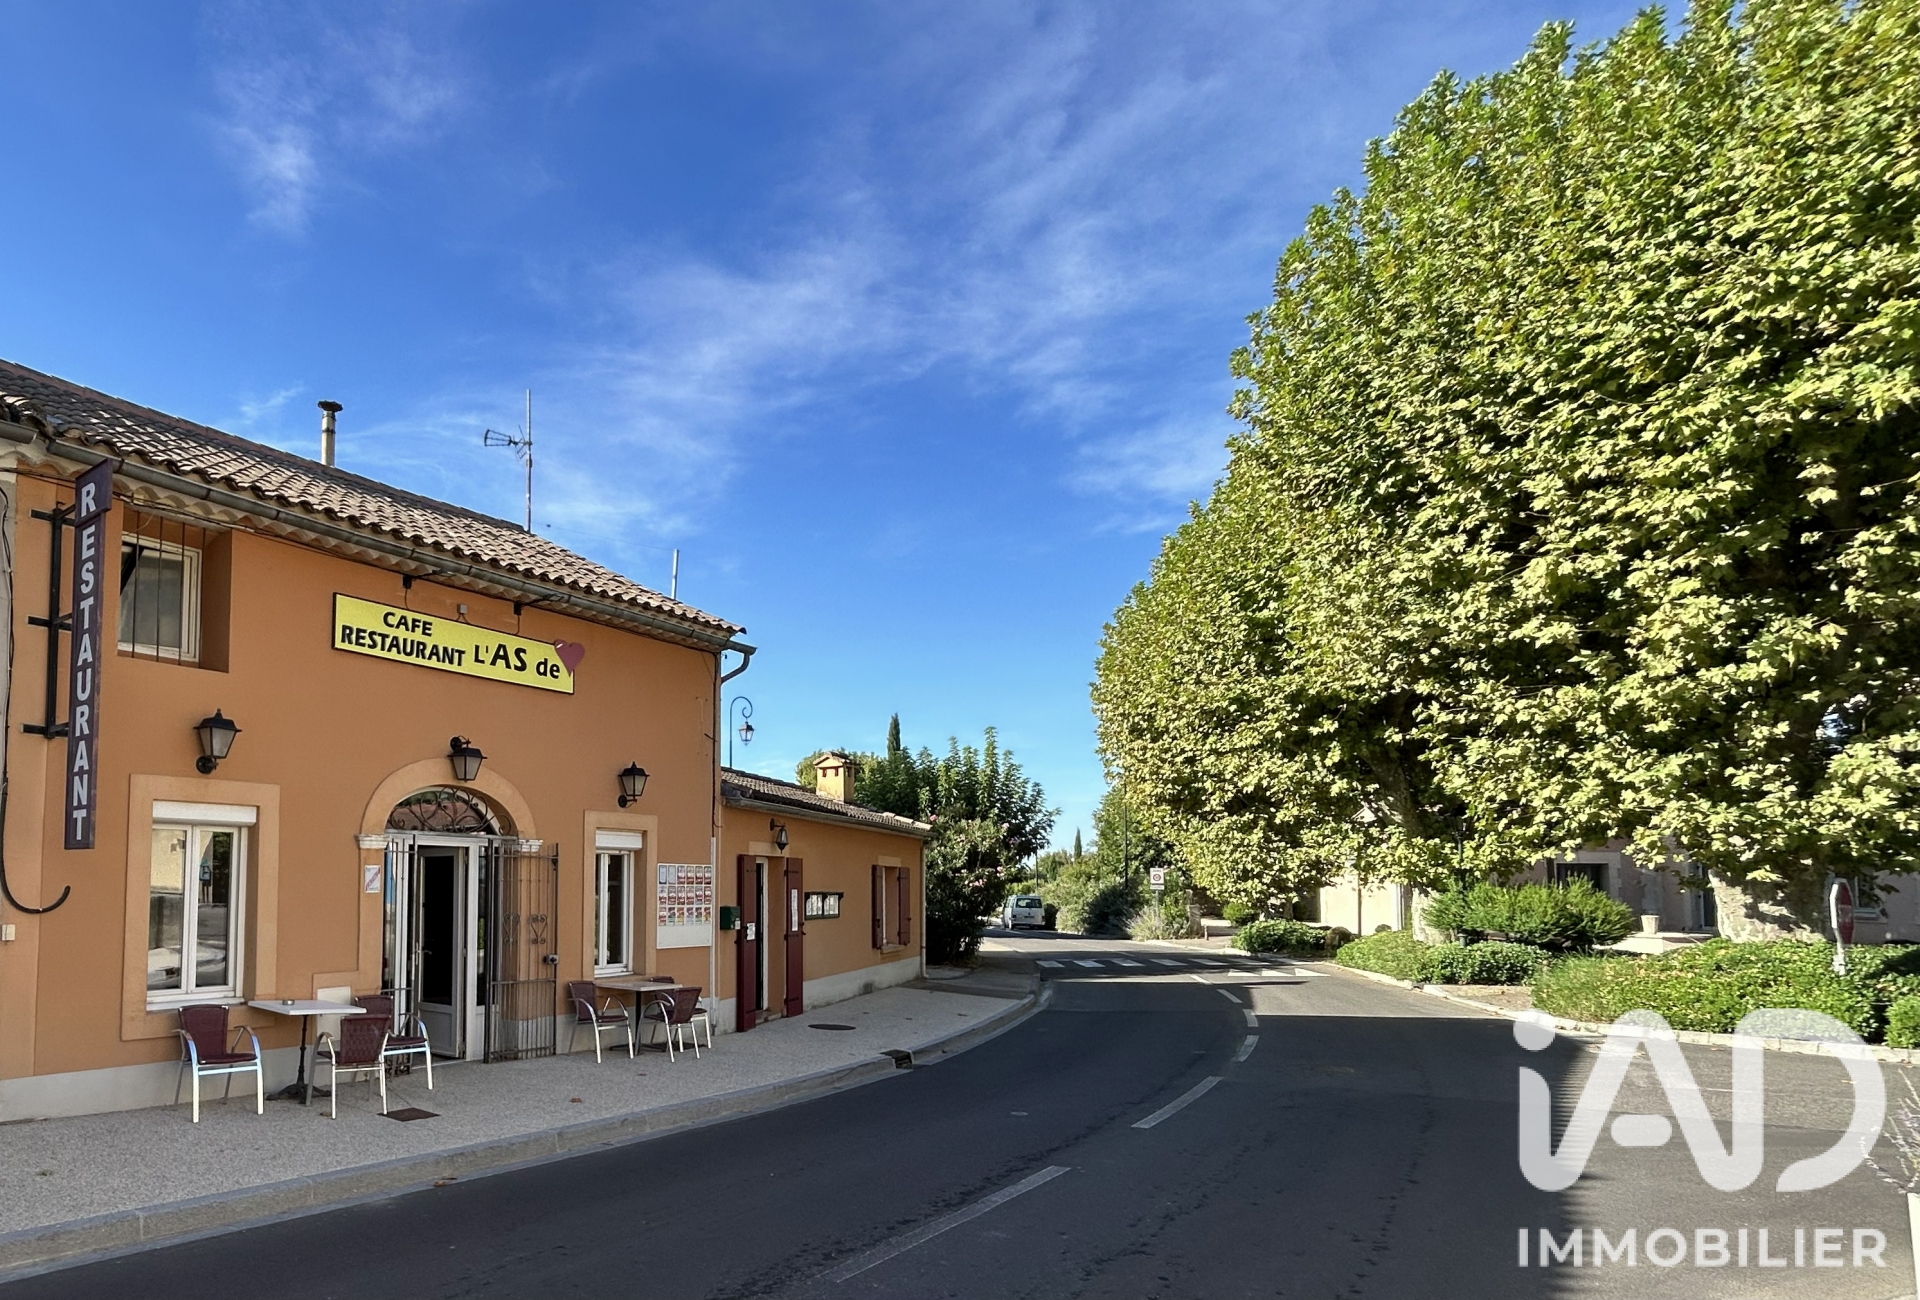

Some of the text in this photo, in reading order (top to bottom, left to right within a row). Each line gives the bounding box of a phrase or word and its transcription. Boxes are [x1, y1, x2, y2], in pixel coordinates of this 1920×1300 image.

[340, 624, 561, 679] RESTAURANT L'AS de
[382, 611, 433, 637] CAFE
[72, 481, 97, 841] RESTAURANT
